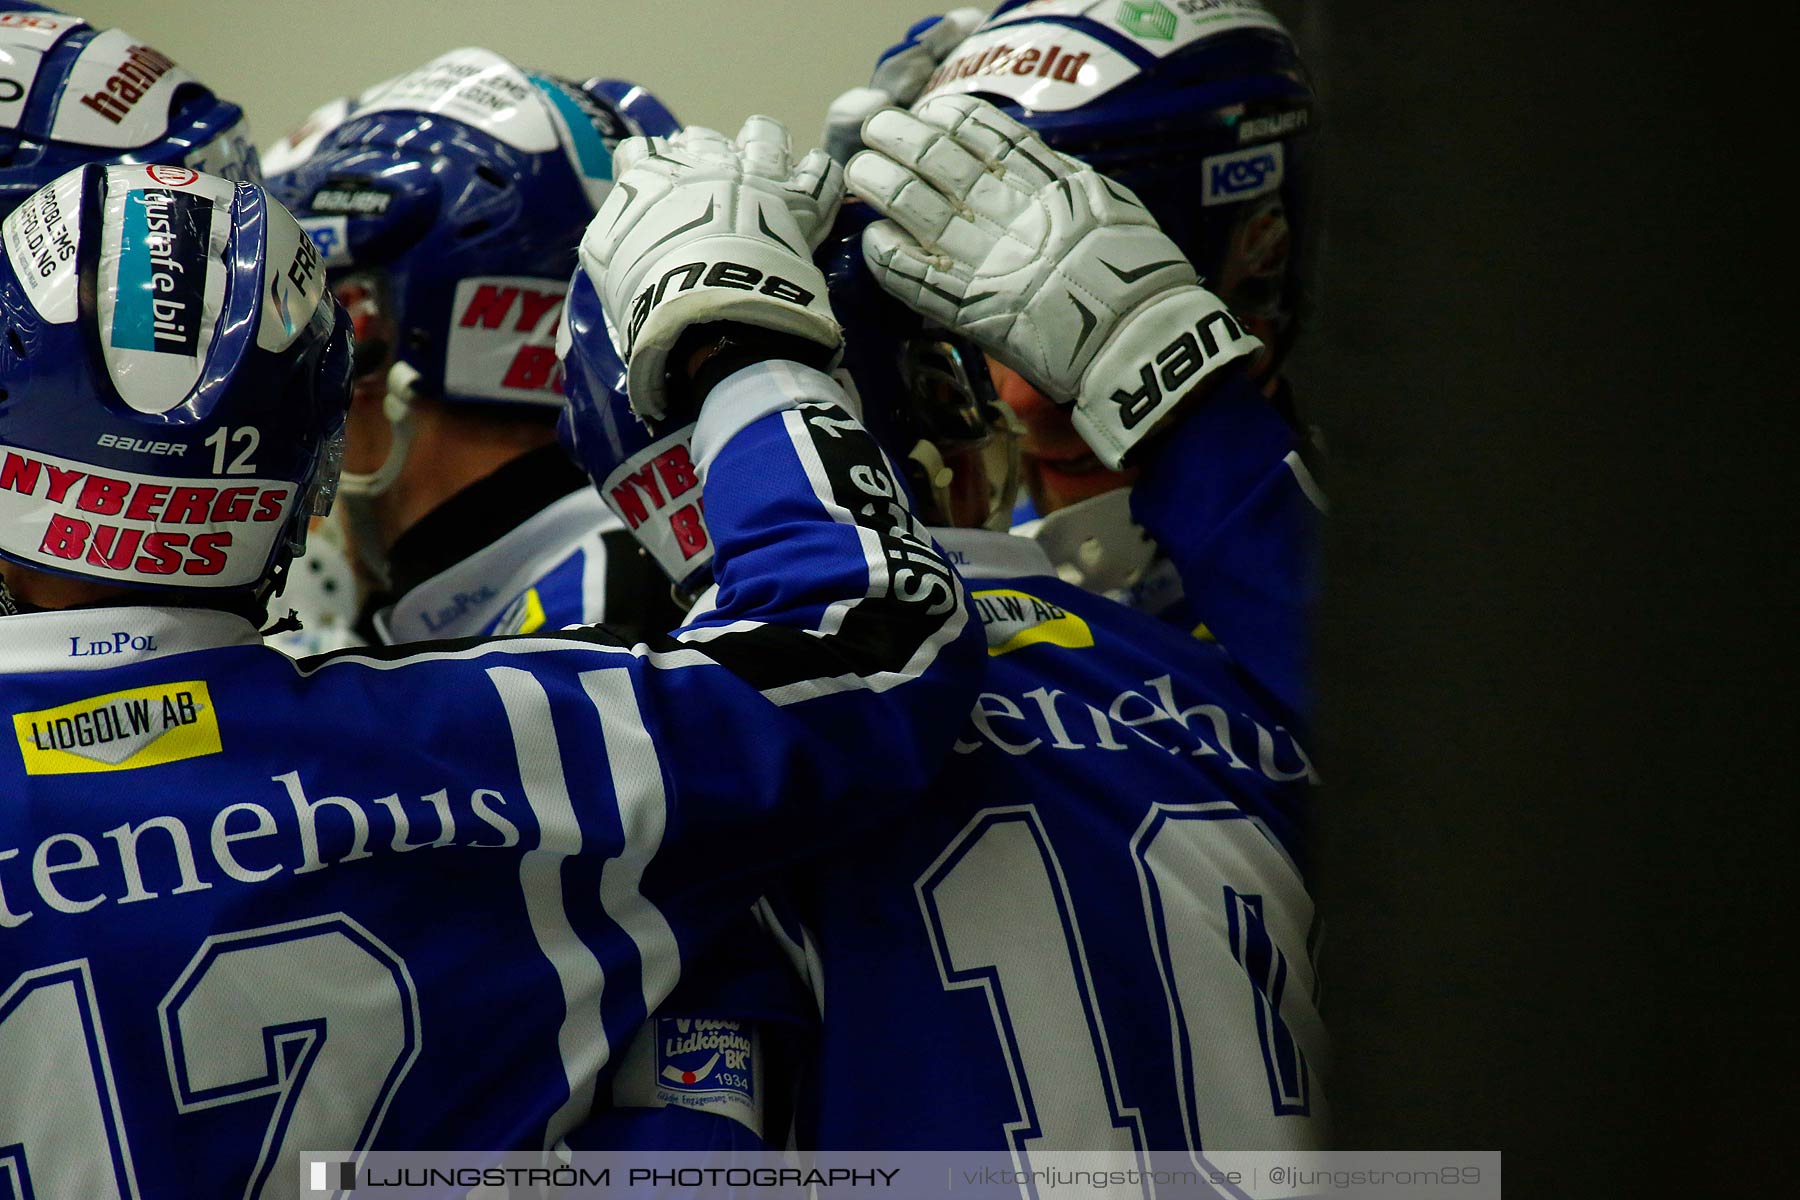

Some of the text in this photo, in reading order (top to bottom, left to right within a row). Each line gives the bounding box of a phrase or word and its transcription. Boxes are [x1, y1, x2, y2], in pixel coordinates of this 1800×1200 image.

[20, 195, 57, 279] CAFFOLDING
[97, 433, 188, 457] BAUER
[204, 425, 260, 475] 12
[0, 451, 289, 525] NYBERGS
[38, 513, 233, 576] BUSS
[668, 495, 709, 562] B
[32, 690, 199, 752] LIDGOLW AB
[953, 673, 1322, 787] enehu
[665, 1030, 752, 1059] Lidköping
[724, 1048, 748, 1071] BK
[714, 1072, 749, 1091] 1934
